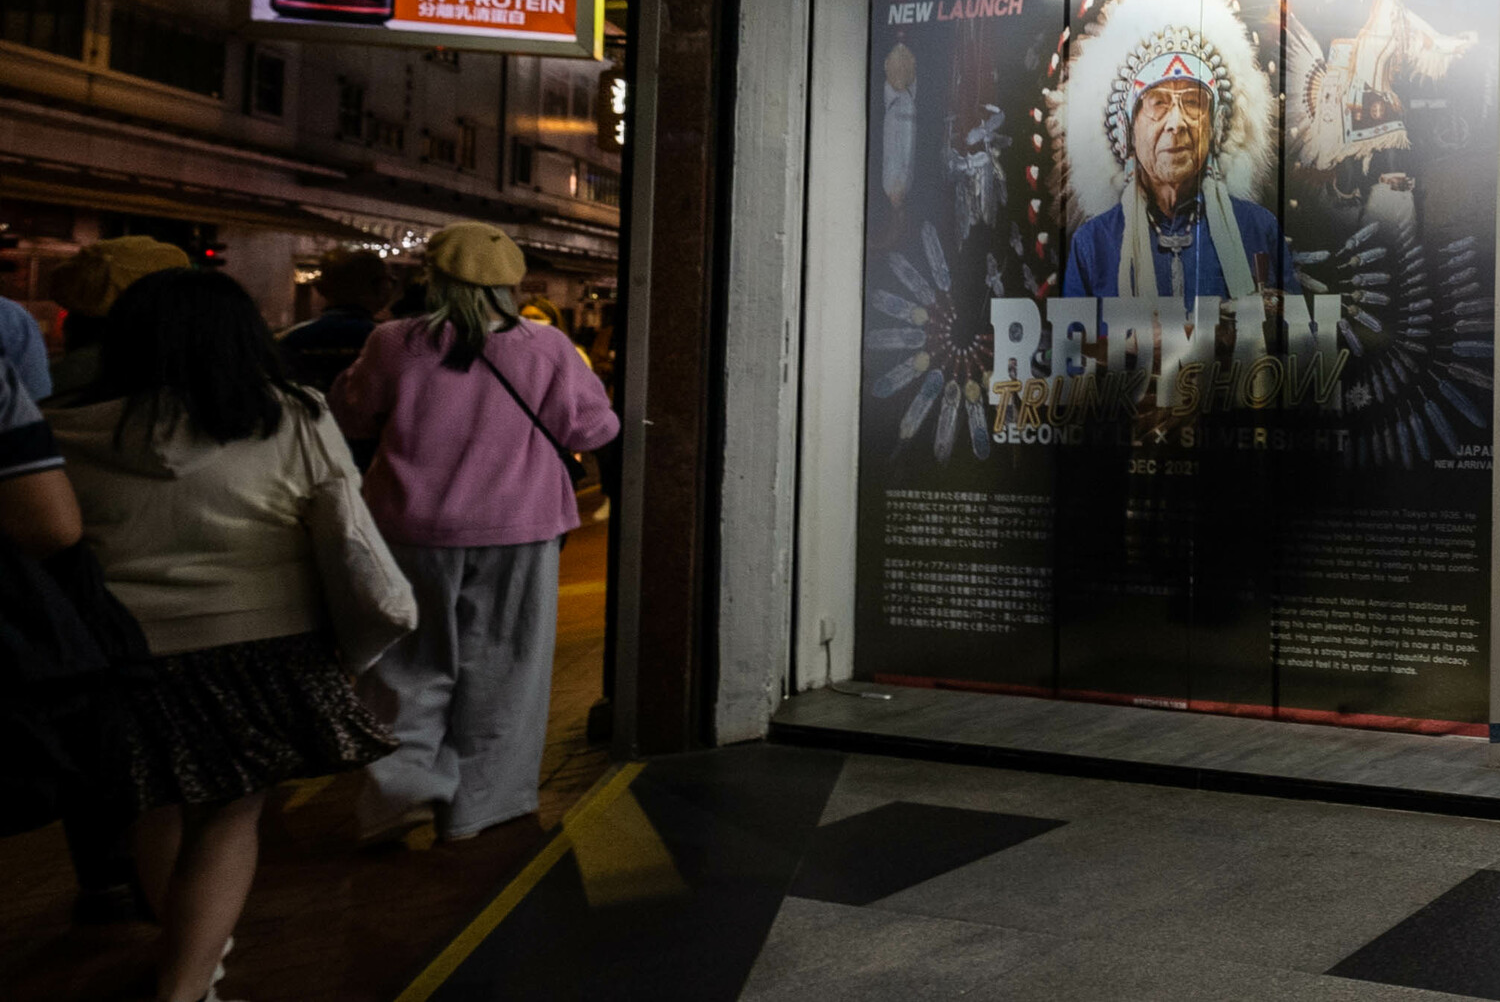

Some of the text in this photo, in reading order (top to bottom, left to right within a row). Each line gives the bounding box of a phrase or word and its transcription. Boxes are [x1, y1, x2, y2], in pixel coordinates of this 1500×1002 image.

[888, 1, 933, 25] NEW
[988, 294, 1344, 410] REDMAN
[993, 348, 1350, 432] TRUNK SHOW
[992, 424, 1083, 446] SECOND
[1434, 459, 1455, 469] NEW
